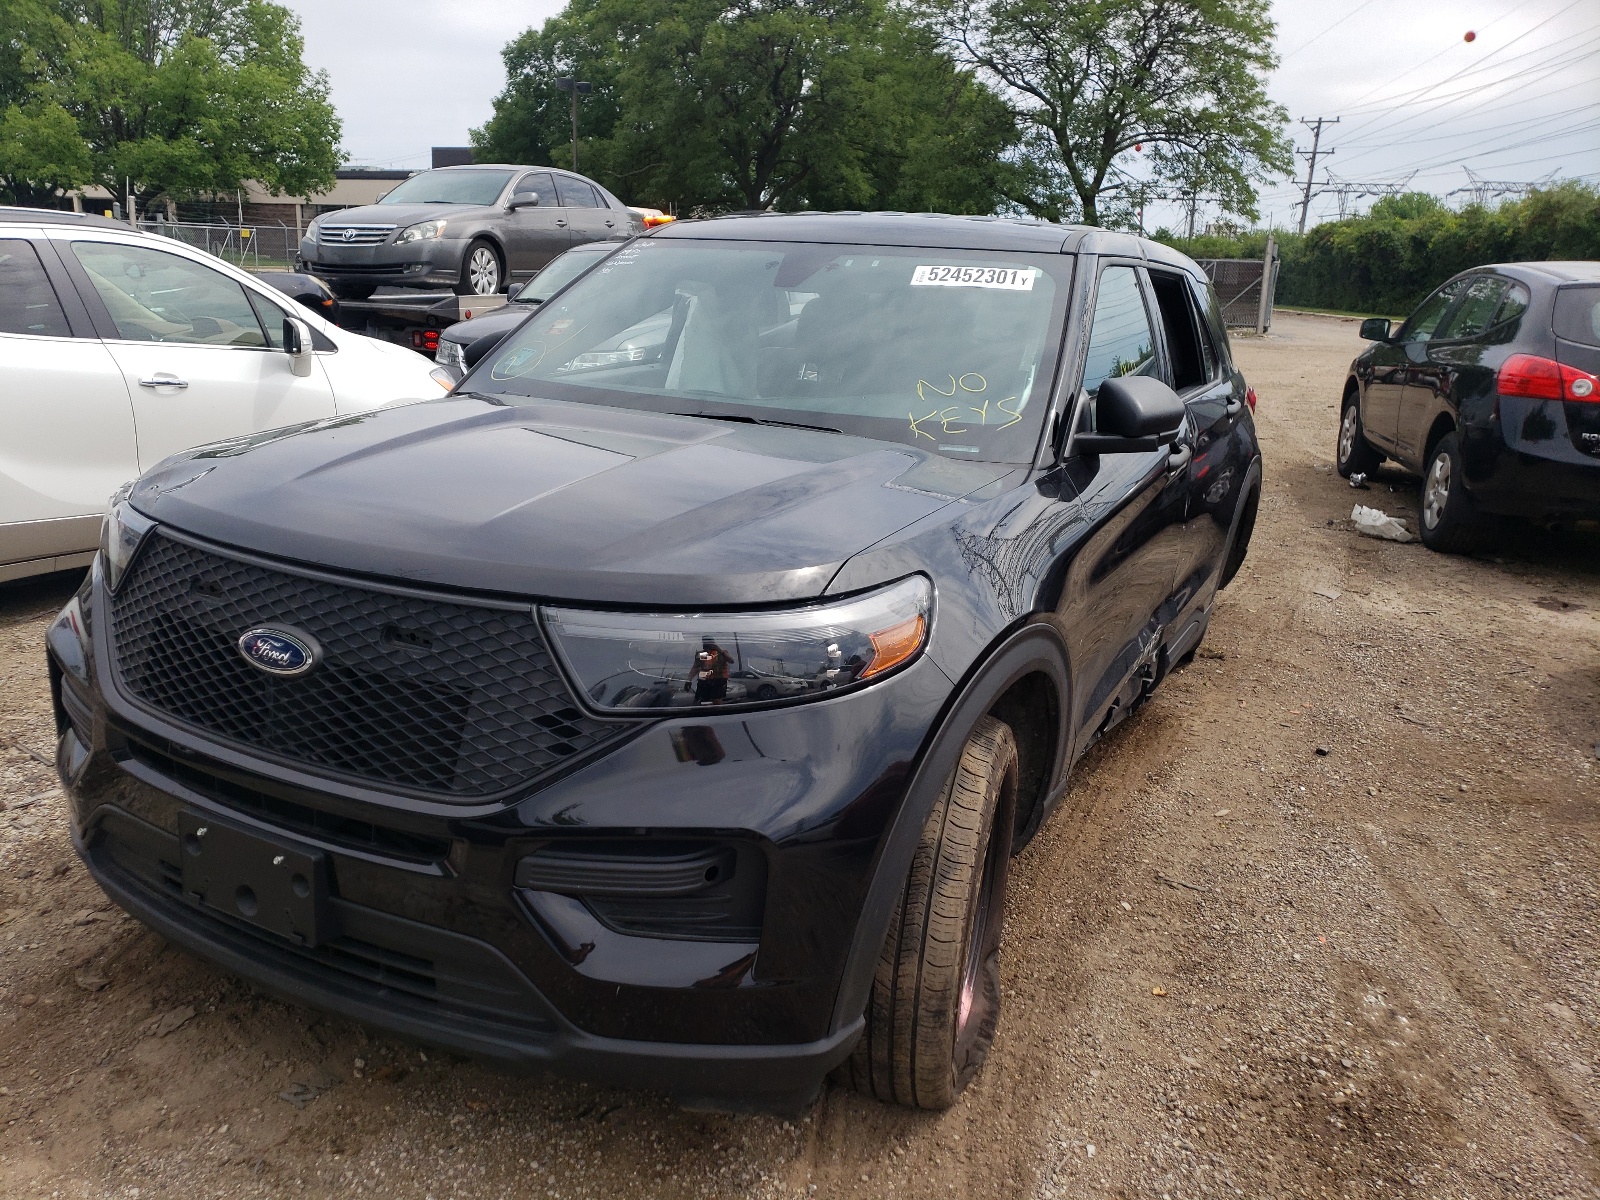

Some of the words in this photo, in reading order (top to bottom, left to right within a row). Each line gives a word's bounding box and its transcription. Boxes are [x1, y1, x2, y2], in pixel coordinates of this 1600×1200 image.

[927, 266, 1018, 285] 52452301
[1021, 276, 1029, 286] Y
[917, 372, 987, 401] NO
[909, 396, 1023, 441] KEYS
[251, 637, 293, 666] Ford
